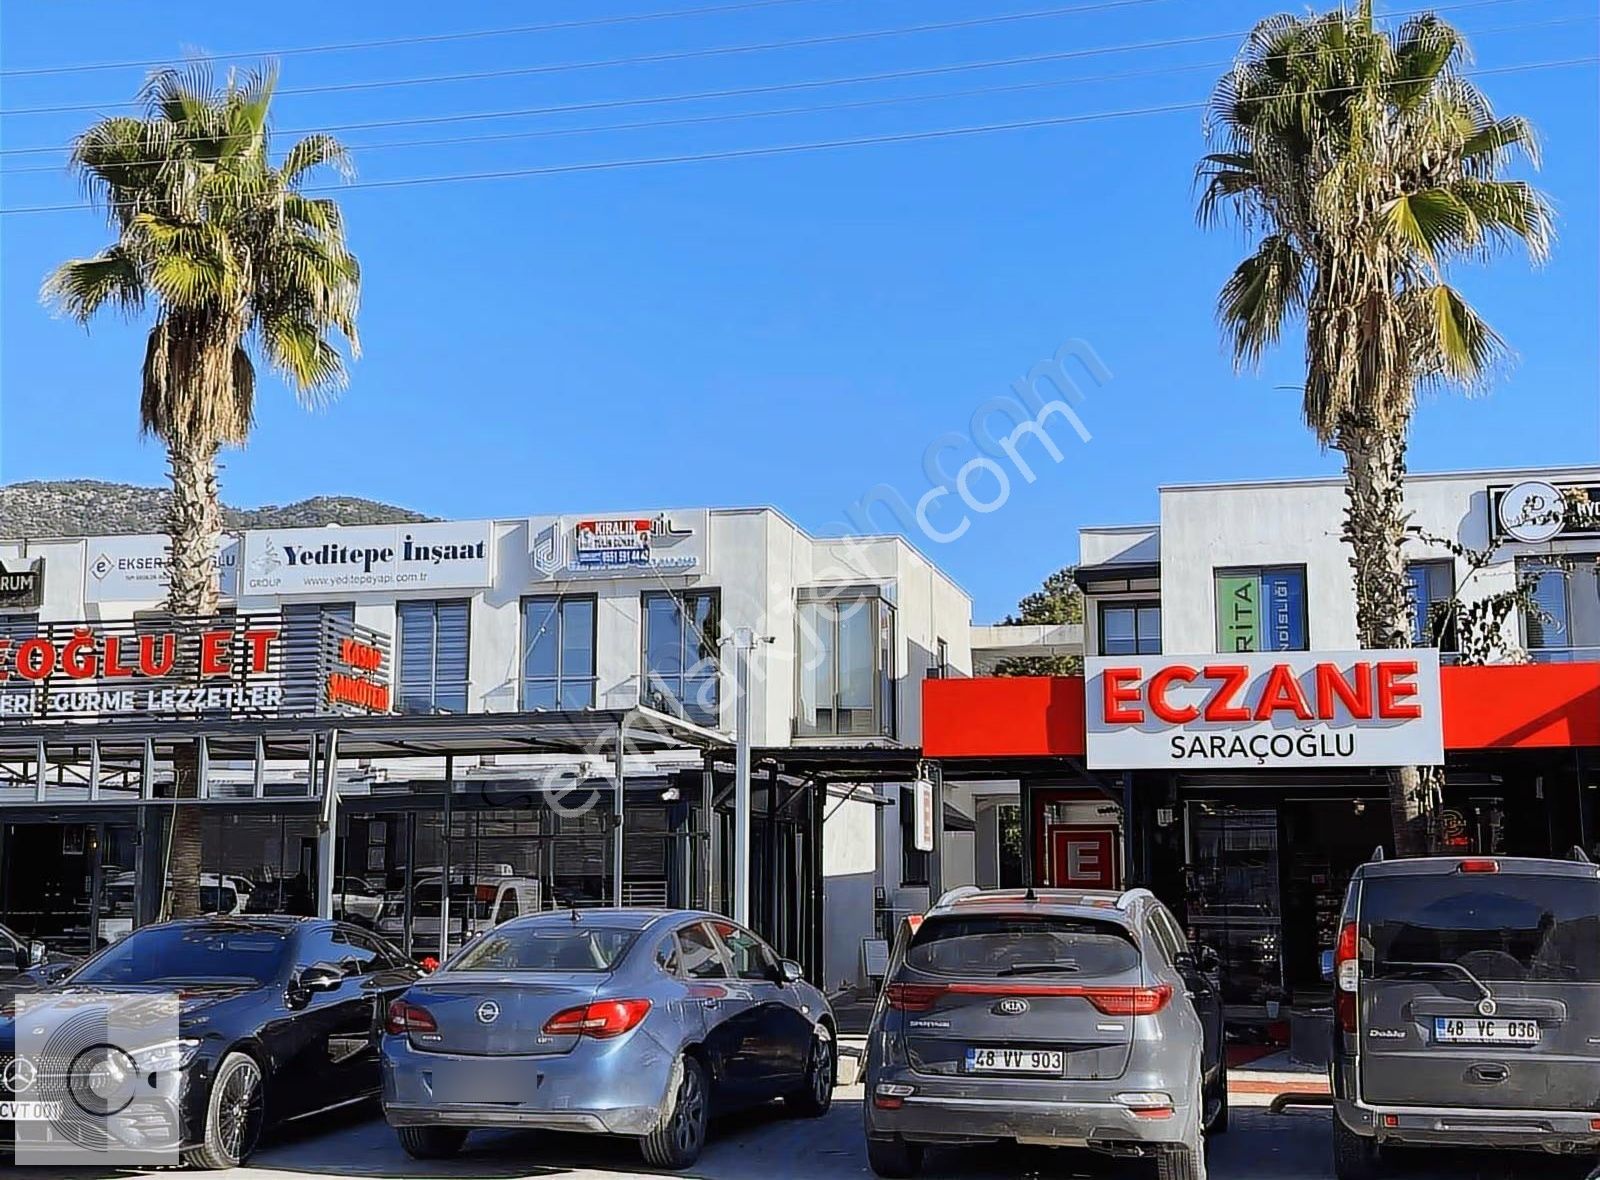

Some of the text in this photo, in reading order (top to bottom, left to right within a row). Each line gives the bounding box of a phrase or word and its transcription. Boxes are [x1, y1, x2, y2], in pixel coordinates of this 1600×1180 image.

[283, 534, 485, 573] Yeditepe İnşaat
[249, 578, 282, 588] GROUP
[201, 630, 280, 679] ET
[148, 687, 282, 709] LEZZETLER
[1103, 660, 1423, 724] ECZANE
[1170, 726, 1356, 765] SARAÇOĞLU
[1067, 841, 1101, 881] E
[1002, 1000, 1026, 1012] KIA
[1447, 1020, 1535, 1038] 48 VC 036
[975, 1048, 1061, 1069] 48 VV 903
[0, 1102, 31, 1119] CVT
